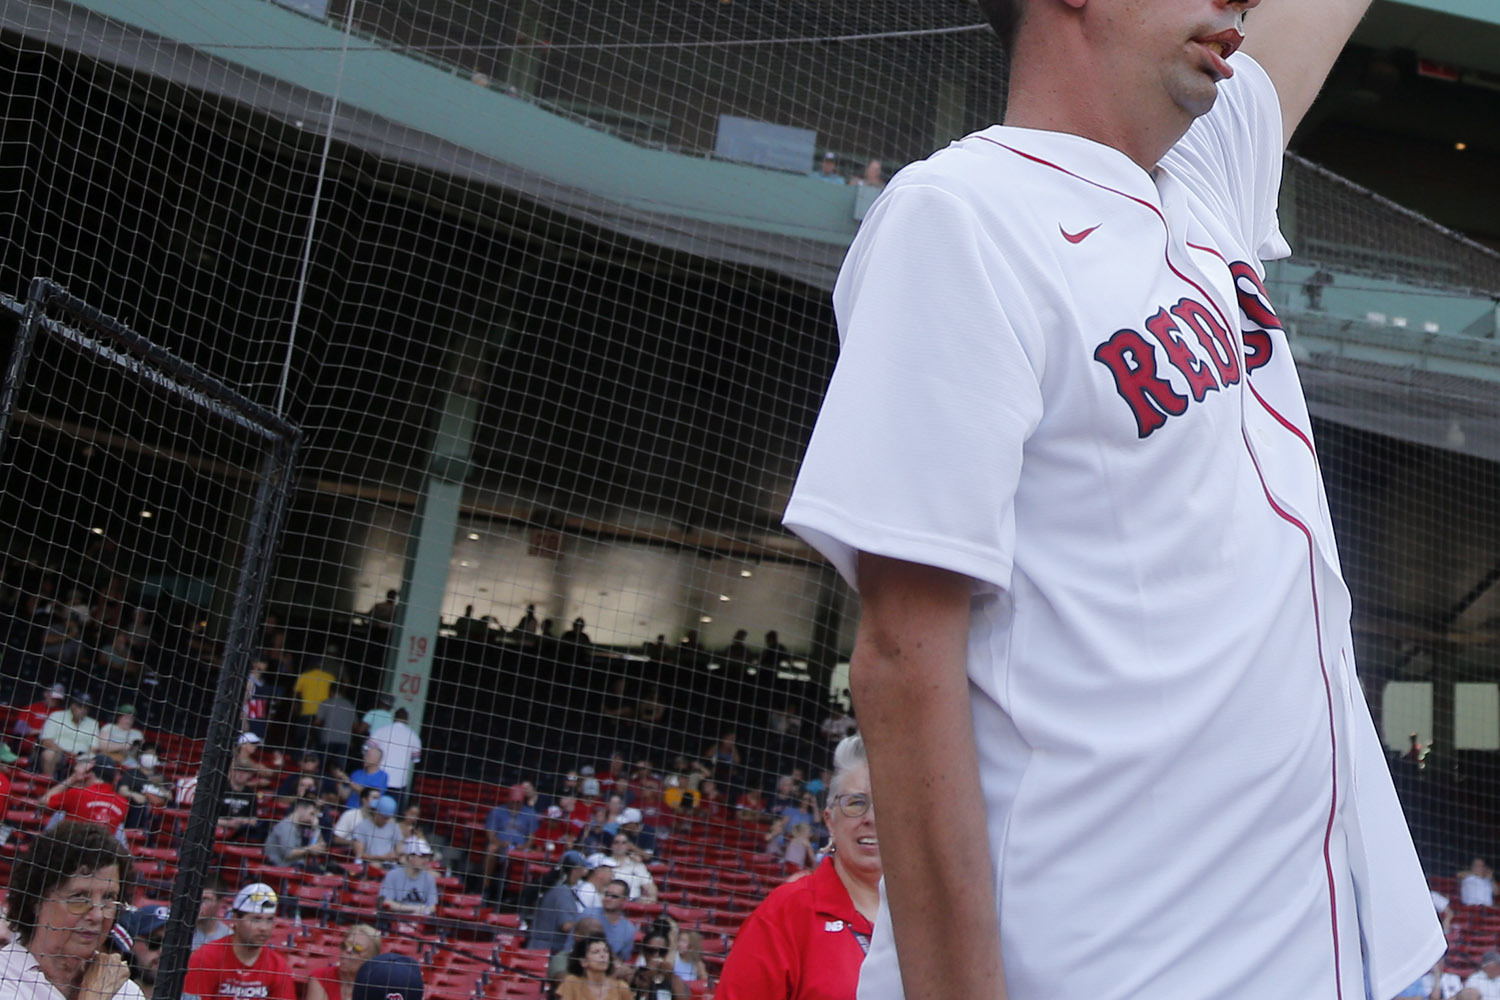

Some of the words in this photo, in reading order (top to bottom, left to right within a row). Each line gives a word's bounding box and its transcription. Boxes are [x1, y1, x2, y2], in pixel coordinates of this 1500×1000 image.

[1094, 297, 1240, 440] RED
[409, 636, 428, 657] 19
[400, 673, 422, 696] 20
